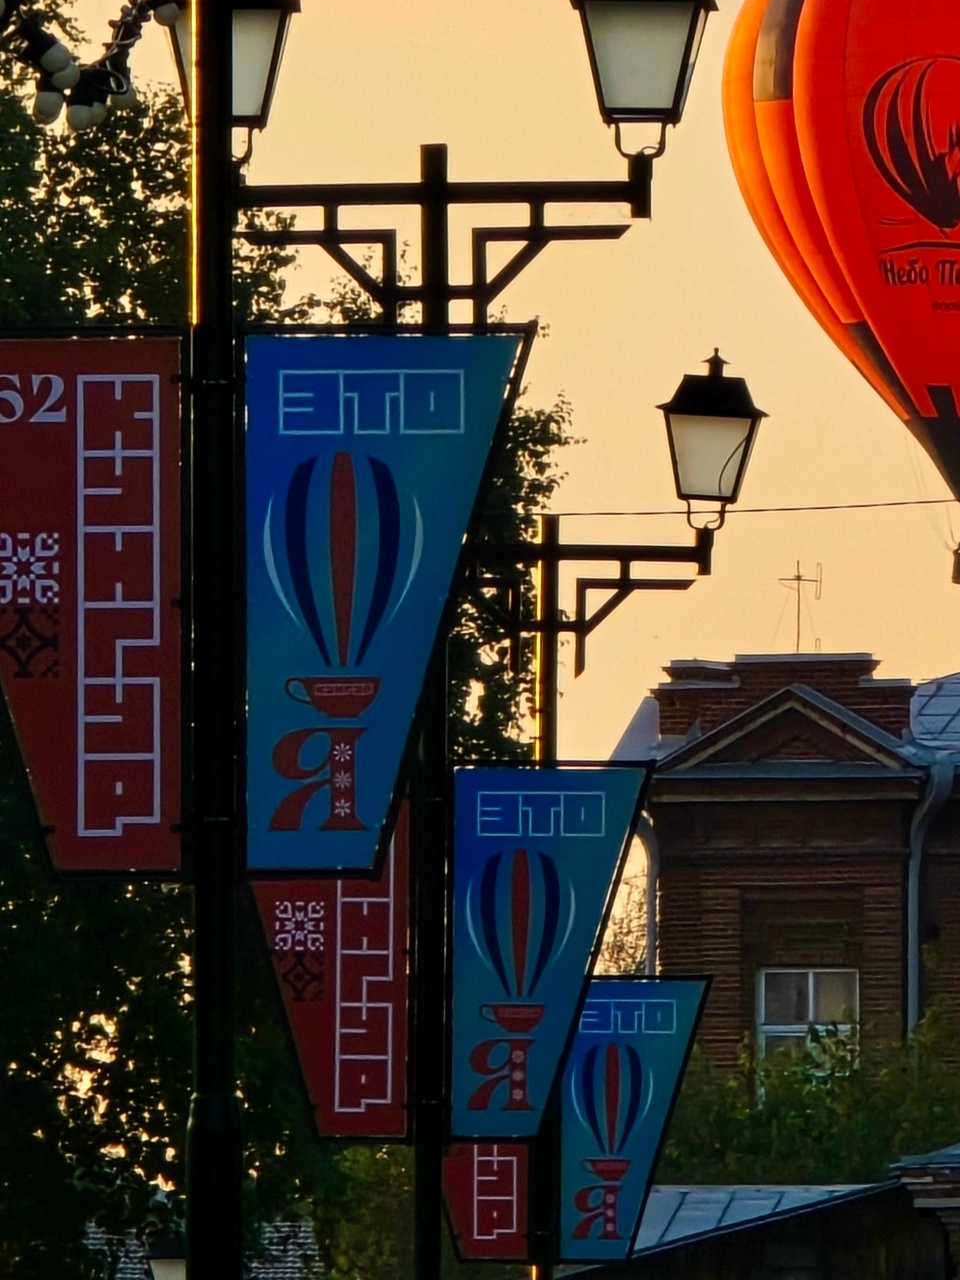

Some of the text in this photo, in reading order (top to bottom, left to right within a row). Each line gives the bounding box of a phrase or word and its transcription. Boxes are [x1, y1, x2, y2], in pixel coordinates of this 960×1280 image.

[878, 258, 930, 286] Небо
[279, 369, 465, 435] ЭТО
[77, 374, 160, 837] КУНГУР
[269, 726, 368, 832] Я
[477, 791, 605, 837] ЭТО
[334, 832, 394, 1113] НГУР
[579, 999, 676, 1034] ЭТО
[467, 1038, 536, 1111] Я
[572, 1185, 624, 1240] Я
